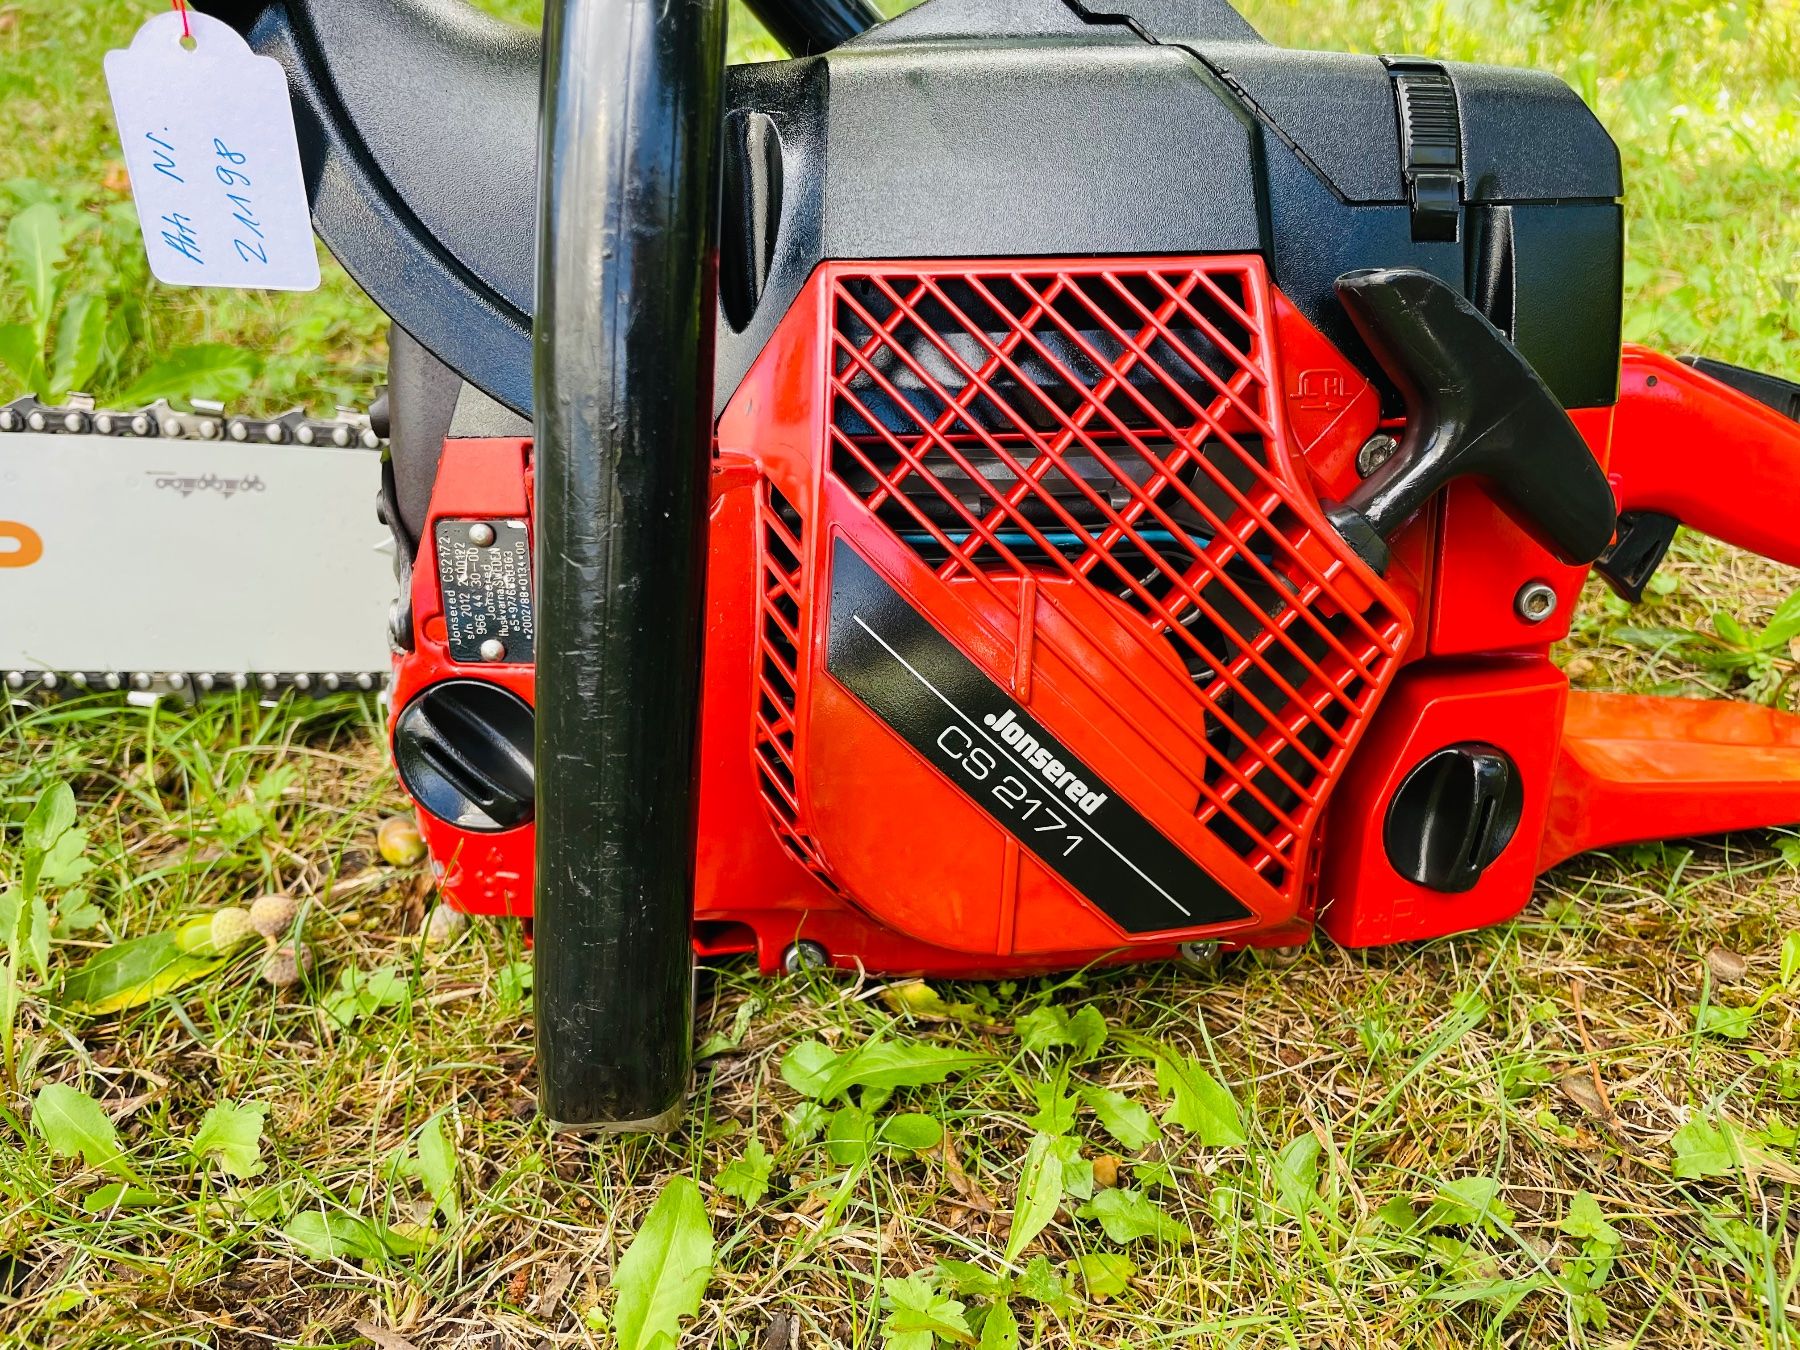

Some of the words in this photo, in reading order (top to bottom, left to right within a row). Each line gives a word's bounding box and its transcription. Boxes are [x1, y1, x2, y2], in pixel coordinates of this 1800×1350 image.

[213, 137, 268, 265] 21198
[438, 536, 454, 583] CS2172
[444, 589, 462, 645] Jonsered
[458, 592, 471, 617] 2012
[472, 594, 483, 607] 44
[480, 564, 496, 620] Jonsered
[463, 623, 475, 640] s/n
[475, 614, 487, 635] 966
[983, 708, 1108, 815] Jonsered
[936, 725, 996, 781] CS
[991, 775, 1084, 857] 2171
